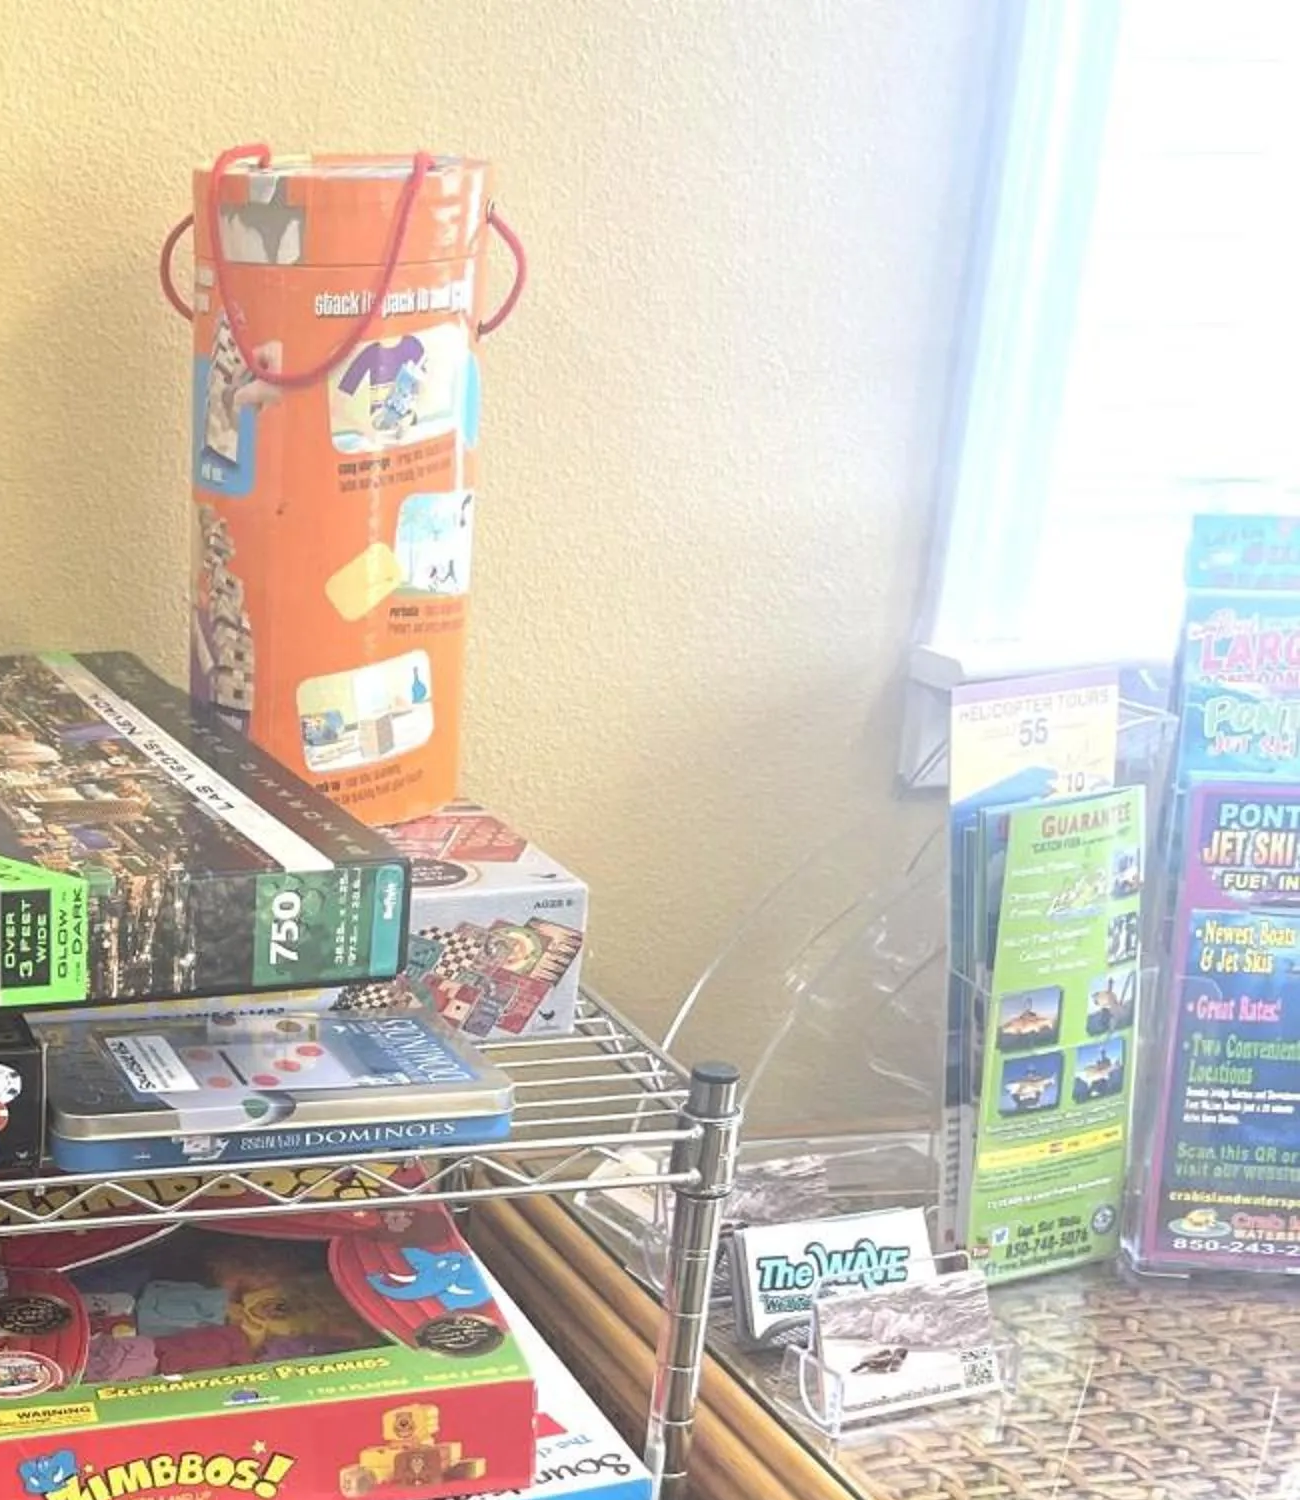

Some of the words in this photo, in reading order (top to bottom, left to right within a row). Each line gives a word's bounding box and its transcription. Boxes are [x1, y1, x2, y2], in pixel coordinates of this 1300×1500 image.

[1042, 802, 1132, 838] GUARANTEE
[4, 911, 17, 969] OVER
[19, 896, 32, 953] FEET
[35, 912, 48, 964] WIDE
[56, 909, 68, 979] GLOW
[71, 885, 84, 956] DARK
[269, 890, 302, 966] 750
[18, 959, 34, 979] 3
[304, 1121, 458, 1147] DOMINOES
[756, 1255, 814, 1292] The
[804, 1238, 910, 1291] WAVE
[95, 1370, 271, 1401] ELEPHANTASTIC
[275, 1357, 392, 1380] PYRAMIDS
[16, 1405, 91, 1420] WARNING
